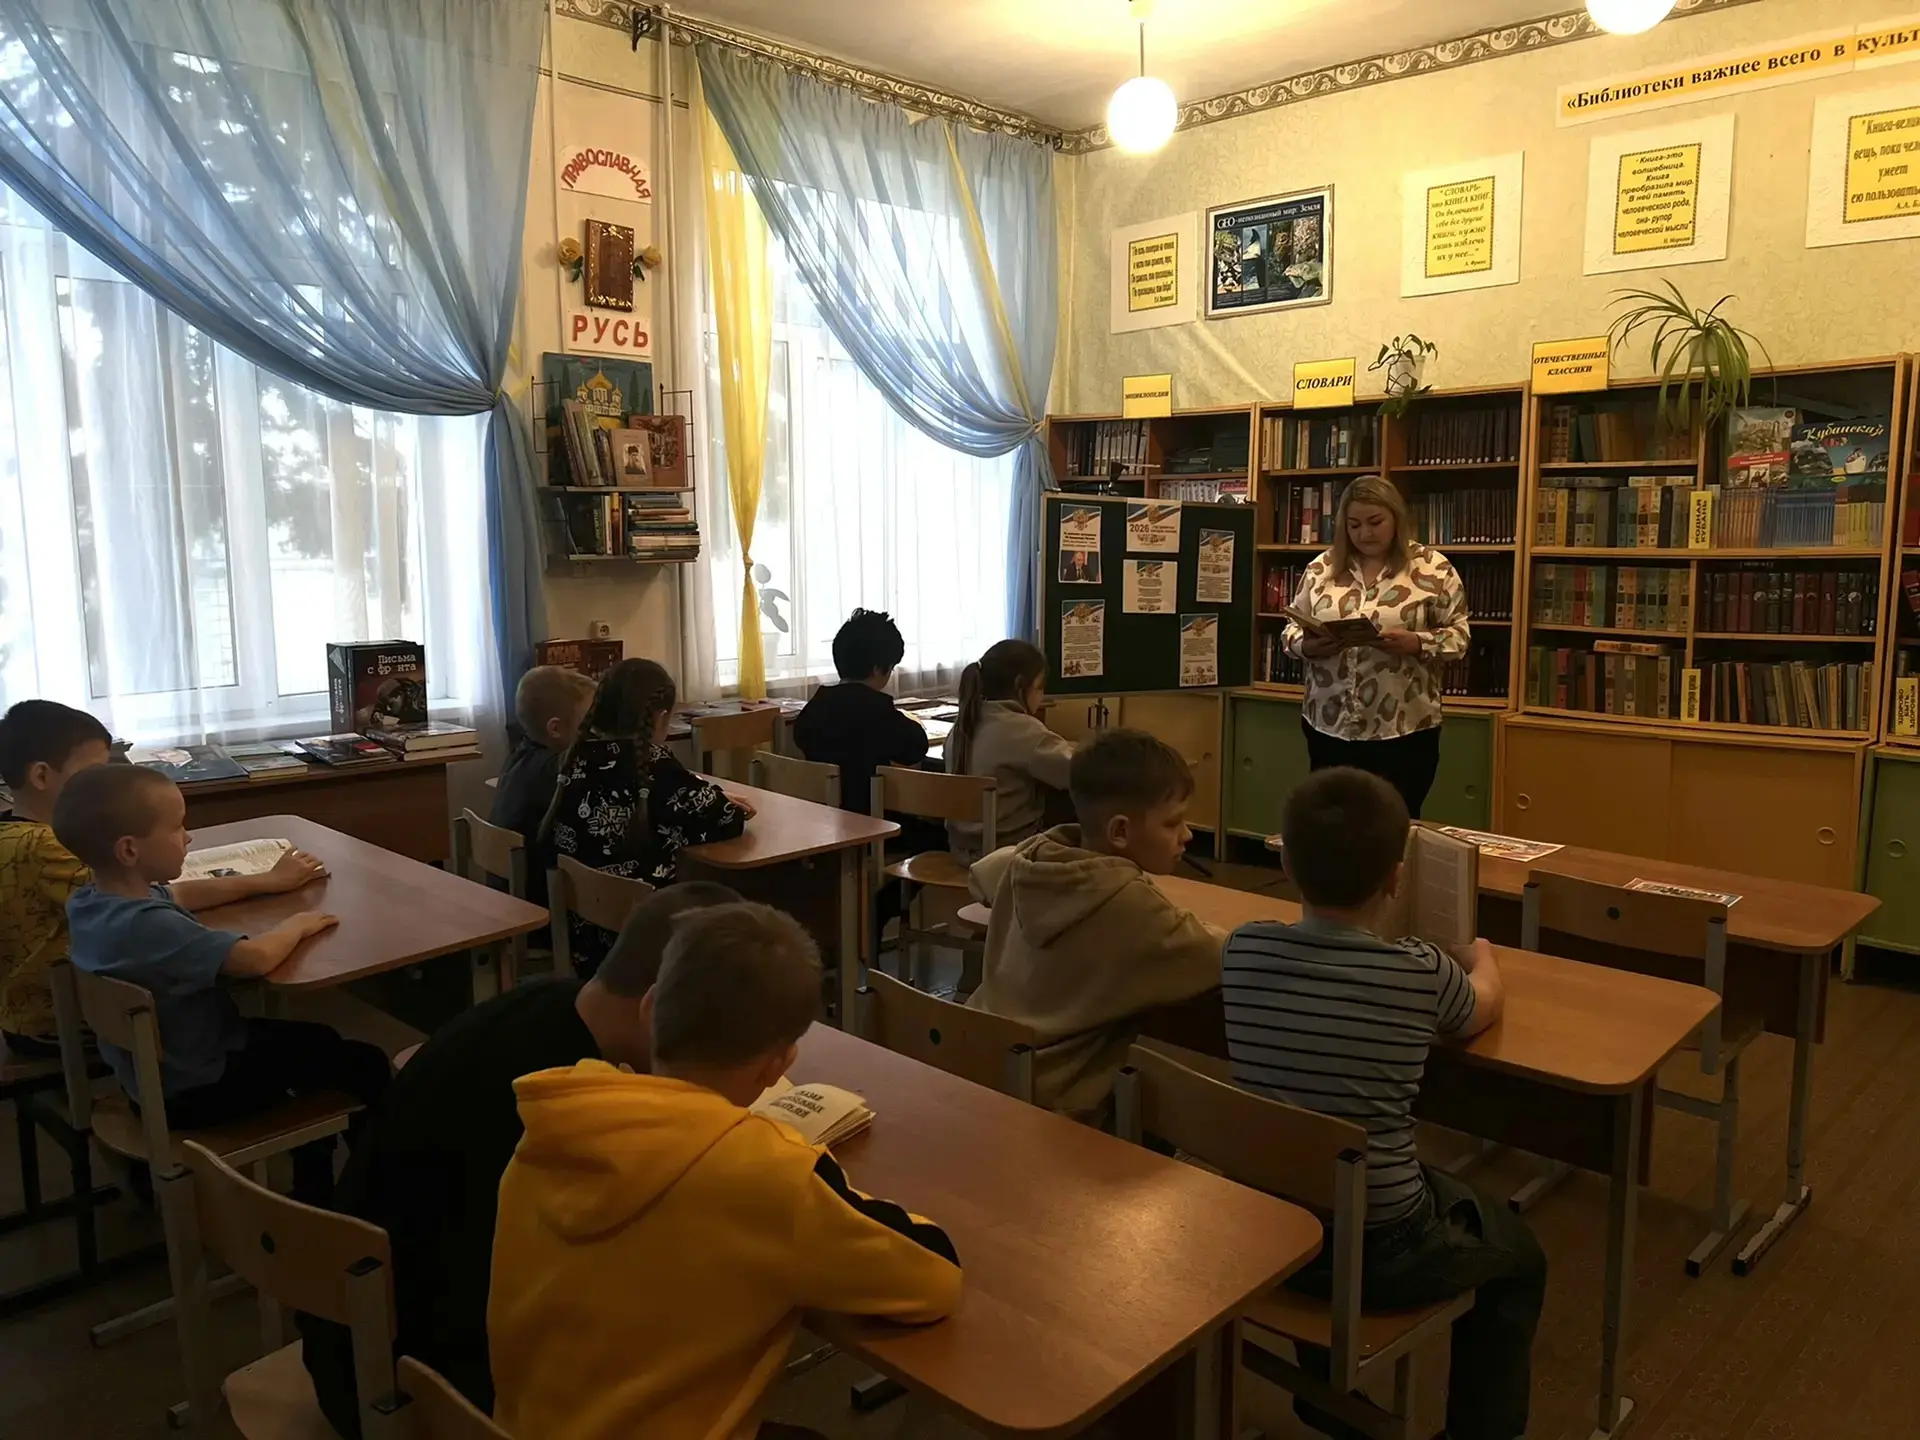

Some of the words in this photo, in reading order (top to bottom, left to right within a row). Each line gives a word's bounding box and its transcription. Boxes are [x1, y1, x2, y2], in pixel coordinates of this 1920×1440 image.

[1567, 76, 1684, 109] «Библиотеки
[1691, 60, 1761, 85] важнее
[1767, 48, 1821, 70] всего
[1833, 44, 1845, 57] в
[561, 148, 651, 199] ПРАВОСЛАВНАЯ
[1646, 173, 1670, 182] Книга
[1878, 164, 1908, 183] умеет
[1621, 181, 1674, 195] преобразила
[1653, 189, 1685, 199] память
[1299, 203, 1321, 213] Земля
[1622, 202, 1671, 215] человеческого
[1651, 213, 1672, 224] рупор
[1618, 224, 1664, 238] человеческой
[572, 314, 649, 348] РУСЬ
[1534, 351, 1608, 364] ОТЕЧЕСТВЕННЫЕ
[1547, 365, 1593, 376] КЛАССИКИ
[1296, 375, 1352, 390] СЛОВАРИ
[1802, 422, 1884, 441] Кубанский
[1129, 523, 1150, 533] 2026
[378, 654, 416, 664] Письма
[367, 666, 374, 675] с
[377, 663, 416, 675] фрнта
